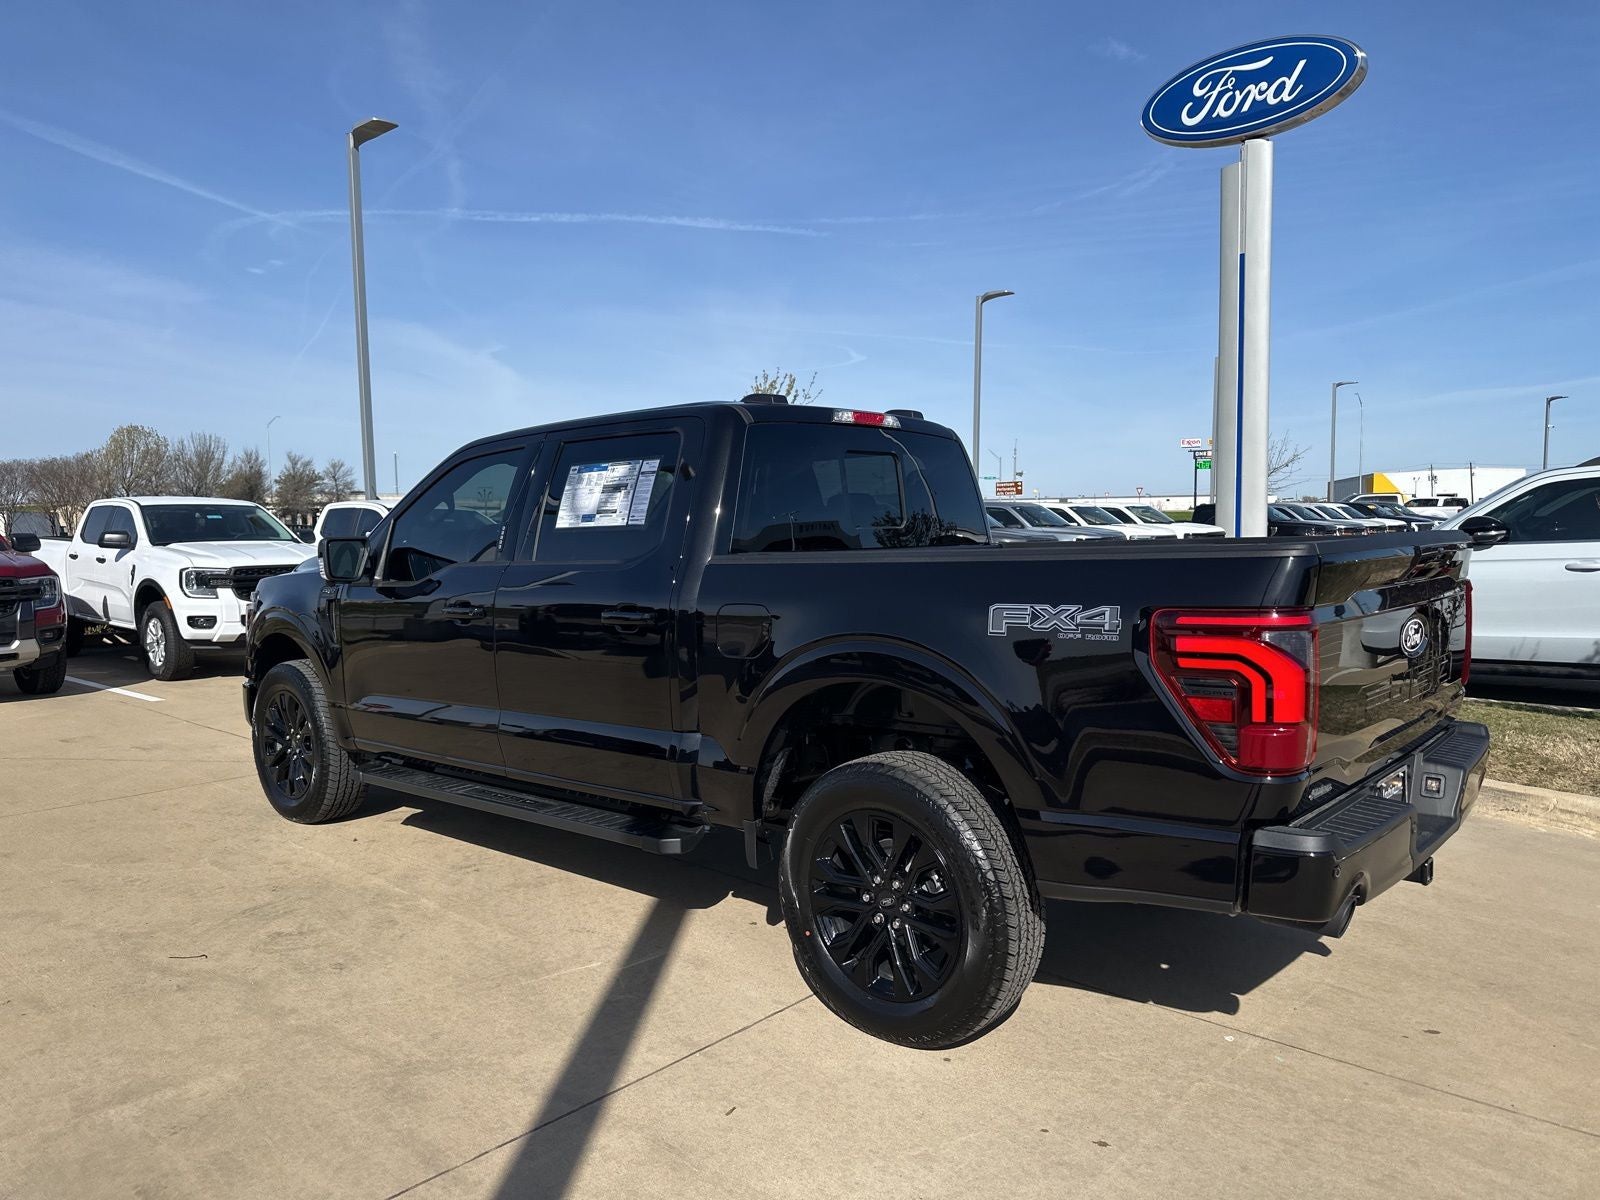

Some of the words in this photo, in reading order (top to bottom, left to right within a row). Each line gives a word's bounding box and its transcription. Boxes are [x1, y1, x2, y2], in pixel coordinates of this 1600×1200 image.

[1181, 56, 1307, 127] Ford
[988, 604, 1121, 636] FX4
[1407, 624, 1422, 647] Ford
